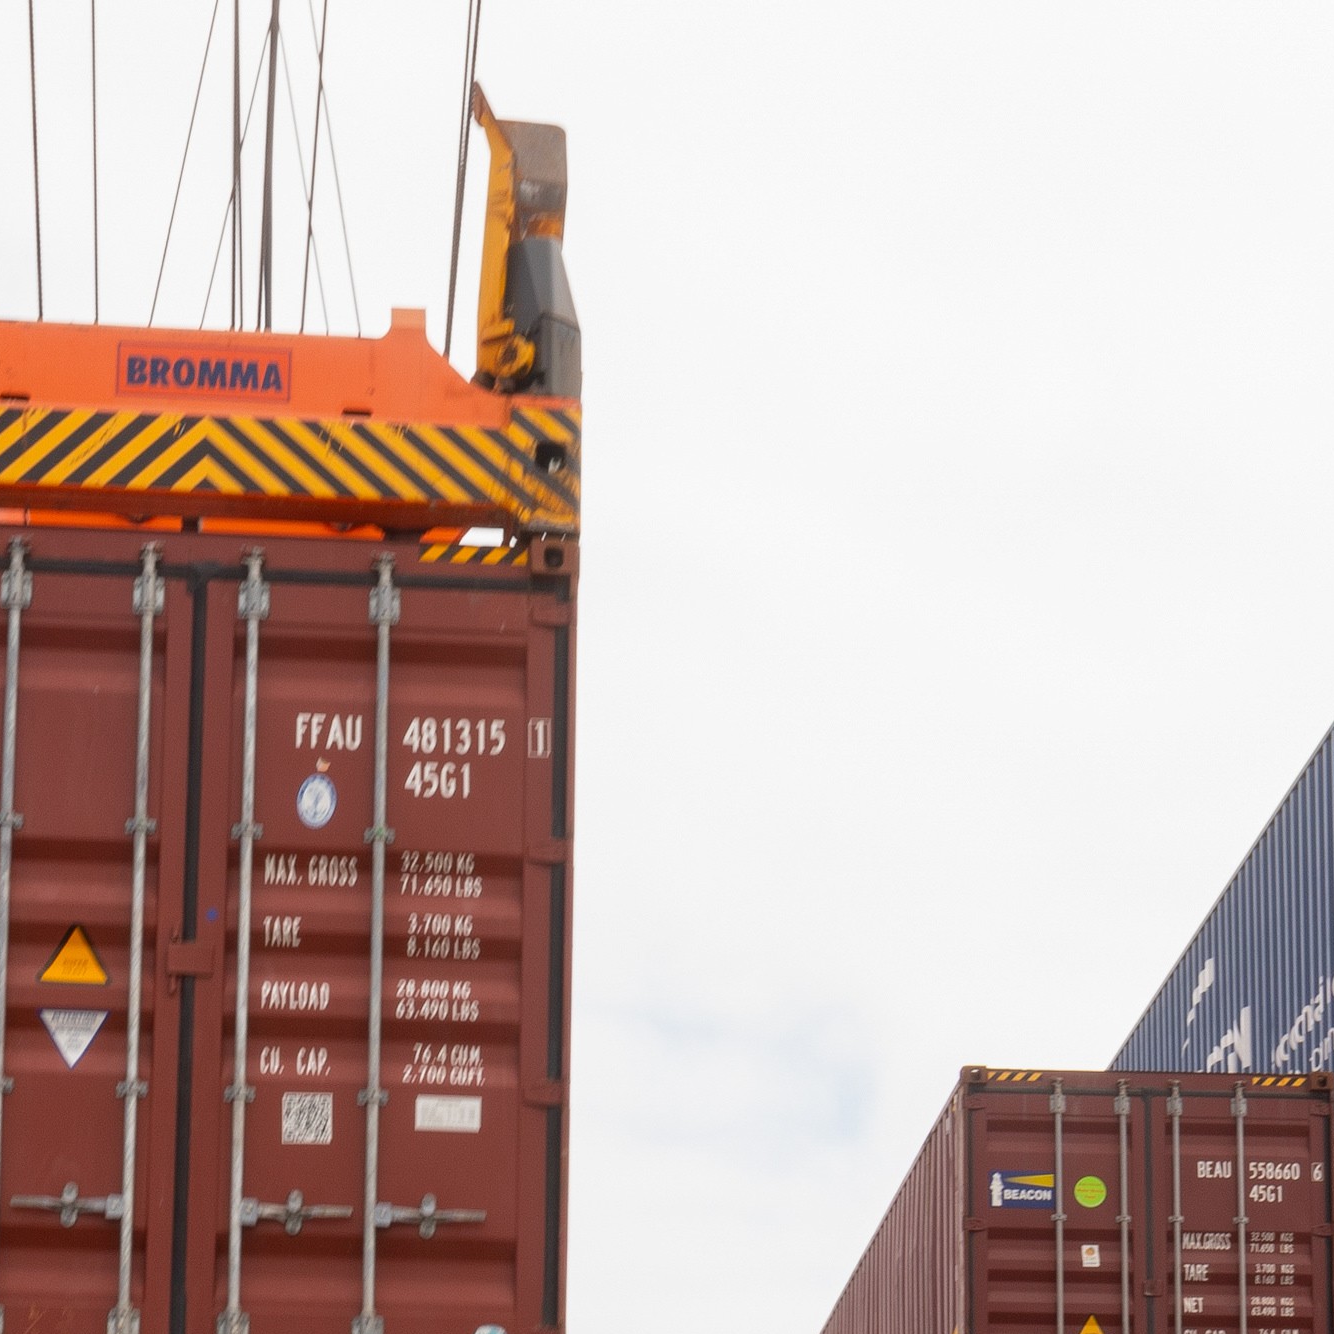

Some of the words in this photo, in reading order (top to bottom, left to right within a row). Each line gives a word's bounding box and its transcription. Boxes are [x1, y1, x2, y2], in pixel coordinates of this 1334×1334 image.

[126, 356, 284, 393] BROMMA
[296, 713, 362, 751] FFAU
[403, 717, 506, 755] 481315
[534, 721, 545, 756] 1
[404, 762, 471, 798] 45G1
[309, 856, 358, 888] GROSS
[264, 916, 301, 948] TARE
[261, 981, 330, 1011] PAYLOAD
[1197, 1161, 1232, 1179] BEAU
[1249, 1162, 1300, 1181] 558660
[1313, 1164, 1322, 1181] 6
[1004, 1189, 1051, 1200] BEACON
[1250, 1184, 1283, 1203] 45G1
[1184, 1264, 1208, 1281] TARE
[1184, 1298, 1203, 1313] NET
